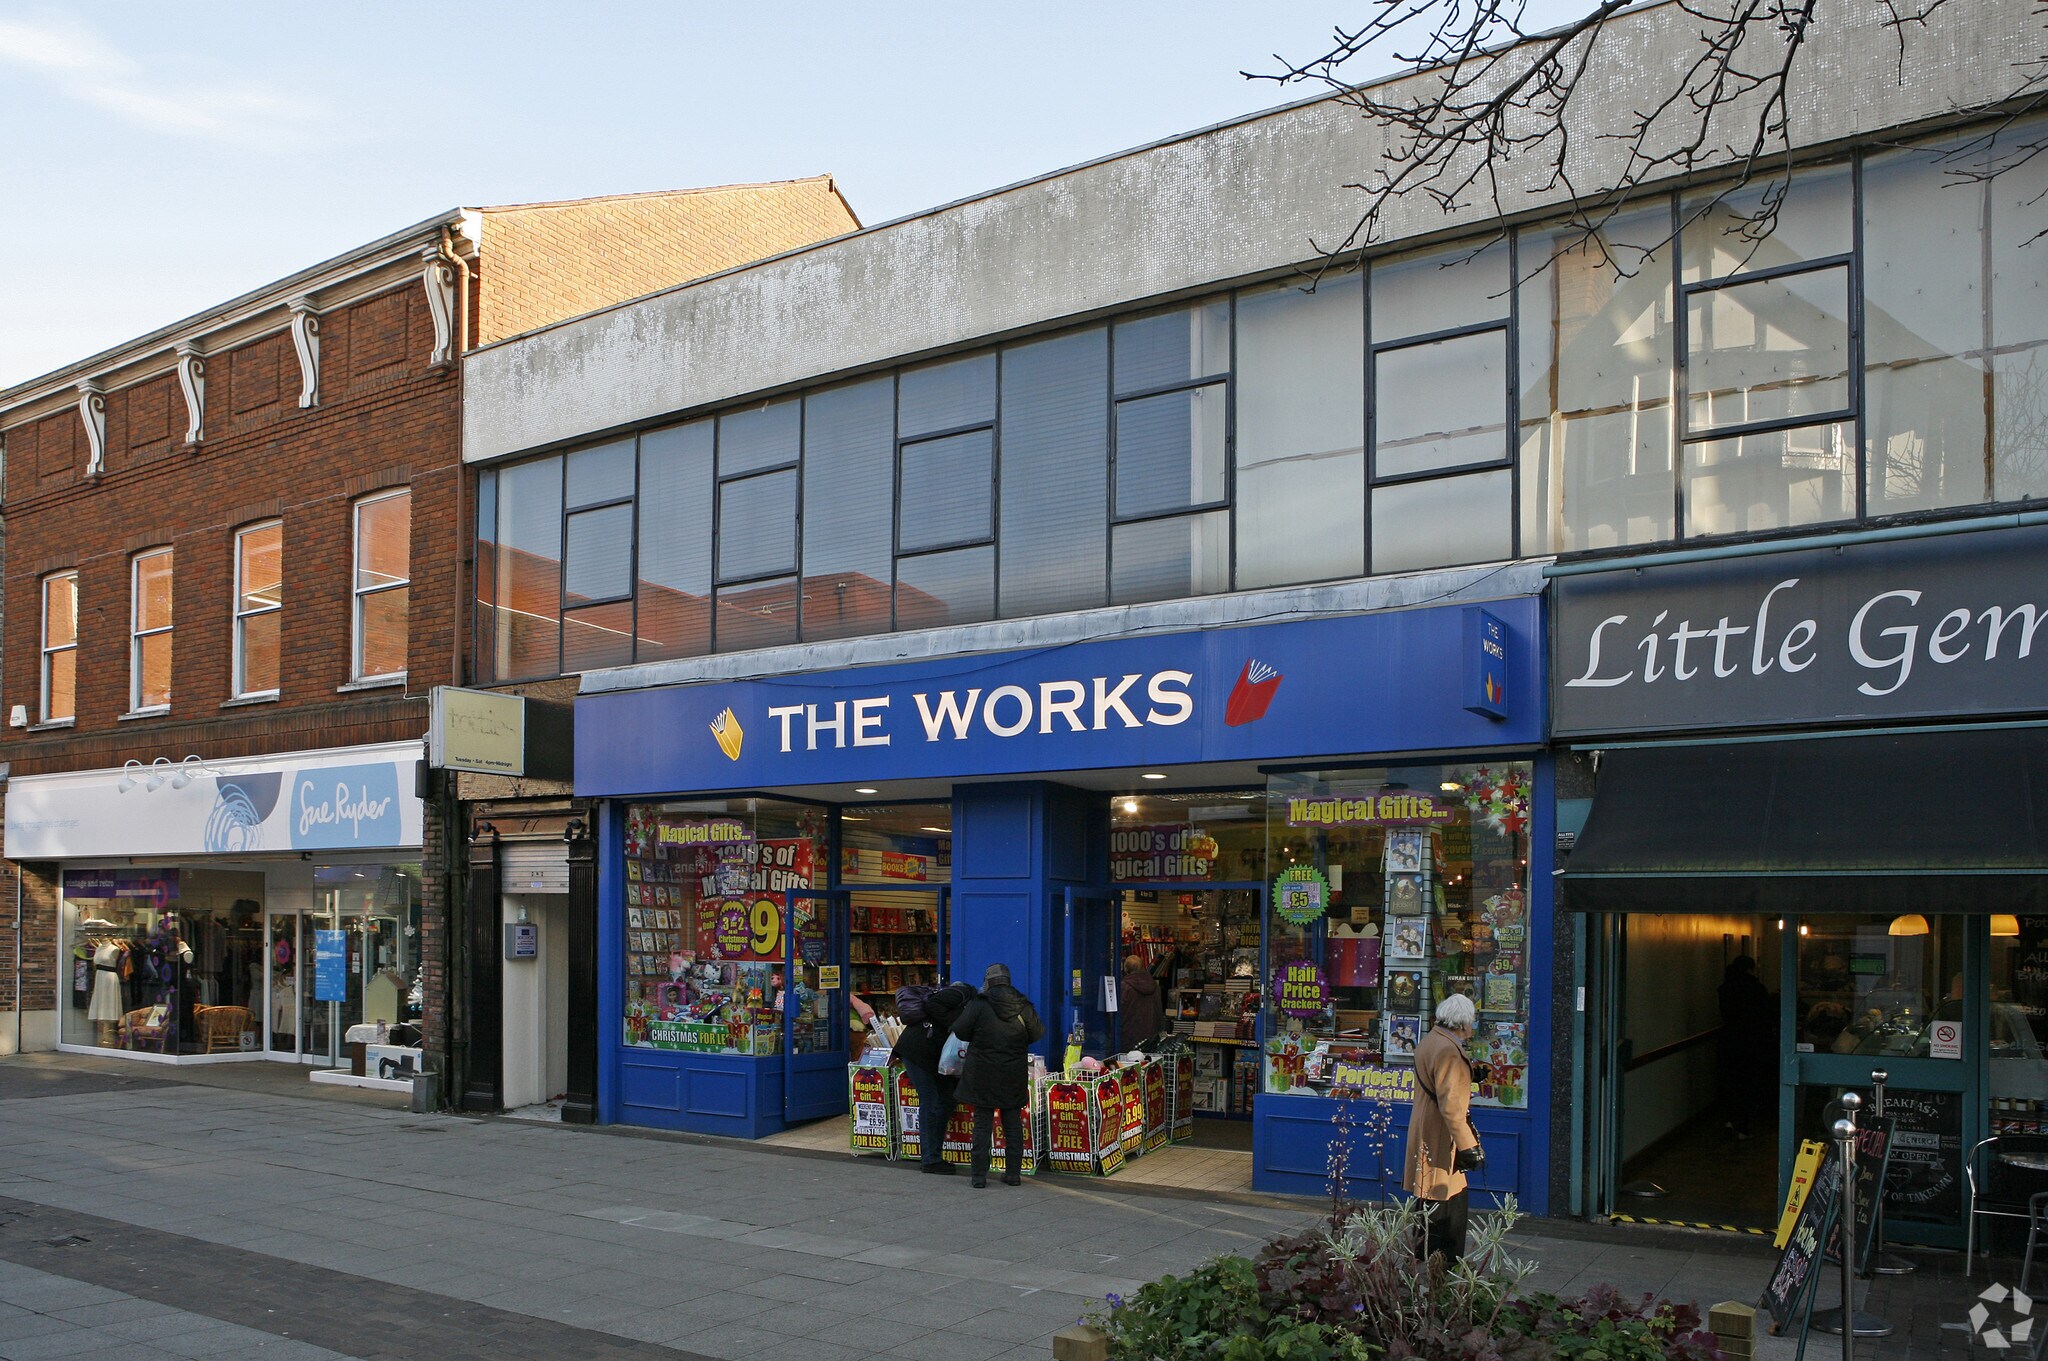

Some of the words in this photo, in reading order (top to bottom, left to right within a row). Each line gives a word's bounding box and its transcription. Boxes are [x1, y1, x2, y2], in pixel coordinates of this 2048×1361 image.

[1487, 622, 1499, 640] THE
[1563, 577, 1801, 688] Little
[1482, 638, 1504, 660] WORKS
[768, 694, 891, 753] THE
[912, 669, 1194, 743] WORKS
[299, 780, 335, 837] Sue
[335, 782, 391, 839] Ryder
[1290, 796, 1375, 825] Magical
[1378, 794, 1448, 820] Gifts...
[659, 822, 709, 844] Magical
[711, 822, 752, 842] Gifts...
[1110, 830, 1166, 853] 1000's
[1169, 828, 1189, 851] of
[776, 845, 797, 867] of
[882, 863, 904, 873] BOOKS
[1164, 854, 1208, 877] Gifts
[1290, 869, 1312, 881] FREE
[87, 879, 99, 887] and
[99, 879, 115, 887] retro
[1291, 892, 1309, 907] £5
[700, 911, 715, 920] From
[722, 917, 729, 931] 3
[738, 917, 744, 931] 2
[718, 934, 748, 944] Christmas
[725, 943, 742, 953] Wrap
[1288, 966, 1317, 982] Half
[1283, 982, 1320, 999] Price
[1281, 998, 1322, 1010] Crackers
[651, 1028, 698, 1044] CHRISTMAS
[699, 1031, 715, 1045] FOR
[716, 1032, 730, 1046] LE
[1335, 1065, 1399, 1089] Perfect
[855, 1081, 881, 1092] Magical
[1365, 1086, 1378, 1097] for
[1394, 1088, 1409, 1100] the
[1053, 1100, 1084, 1111] Magical
[869, 1118, 885, 1127] £6.99
[853, 1126, 887, 1136] CHRISTMAS
[853, 1135, 868, 1146] FOR
[869, 1135, 887, 1148] LESS
[901, 1134, 920, 1143] CHRIS
[1057, 1134, 1083, 1149] FREE
[1122, 1139, 1132, 1151] FOR
[1131, 1133, 1142, 1149] LESS
[1146, 1136, 1156, 1150] FOR
[1156, 1130, 1167, 1145] LESS
[901, 1143, 918, 1155] FOR
[942, 1150, 958, 1162] FOR
[1049, 1150, 1090, 1161] CHRISTMAS
[1101, 1155, 1112, 1171] FOR
[1111, 1149, 1123, 1166] LESS
[1901, 1152, 1929, 1161] OPEN
[1051, 1160, 1068, 1171] FOR
[1069, 1161, 1091, 1172] LESS
